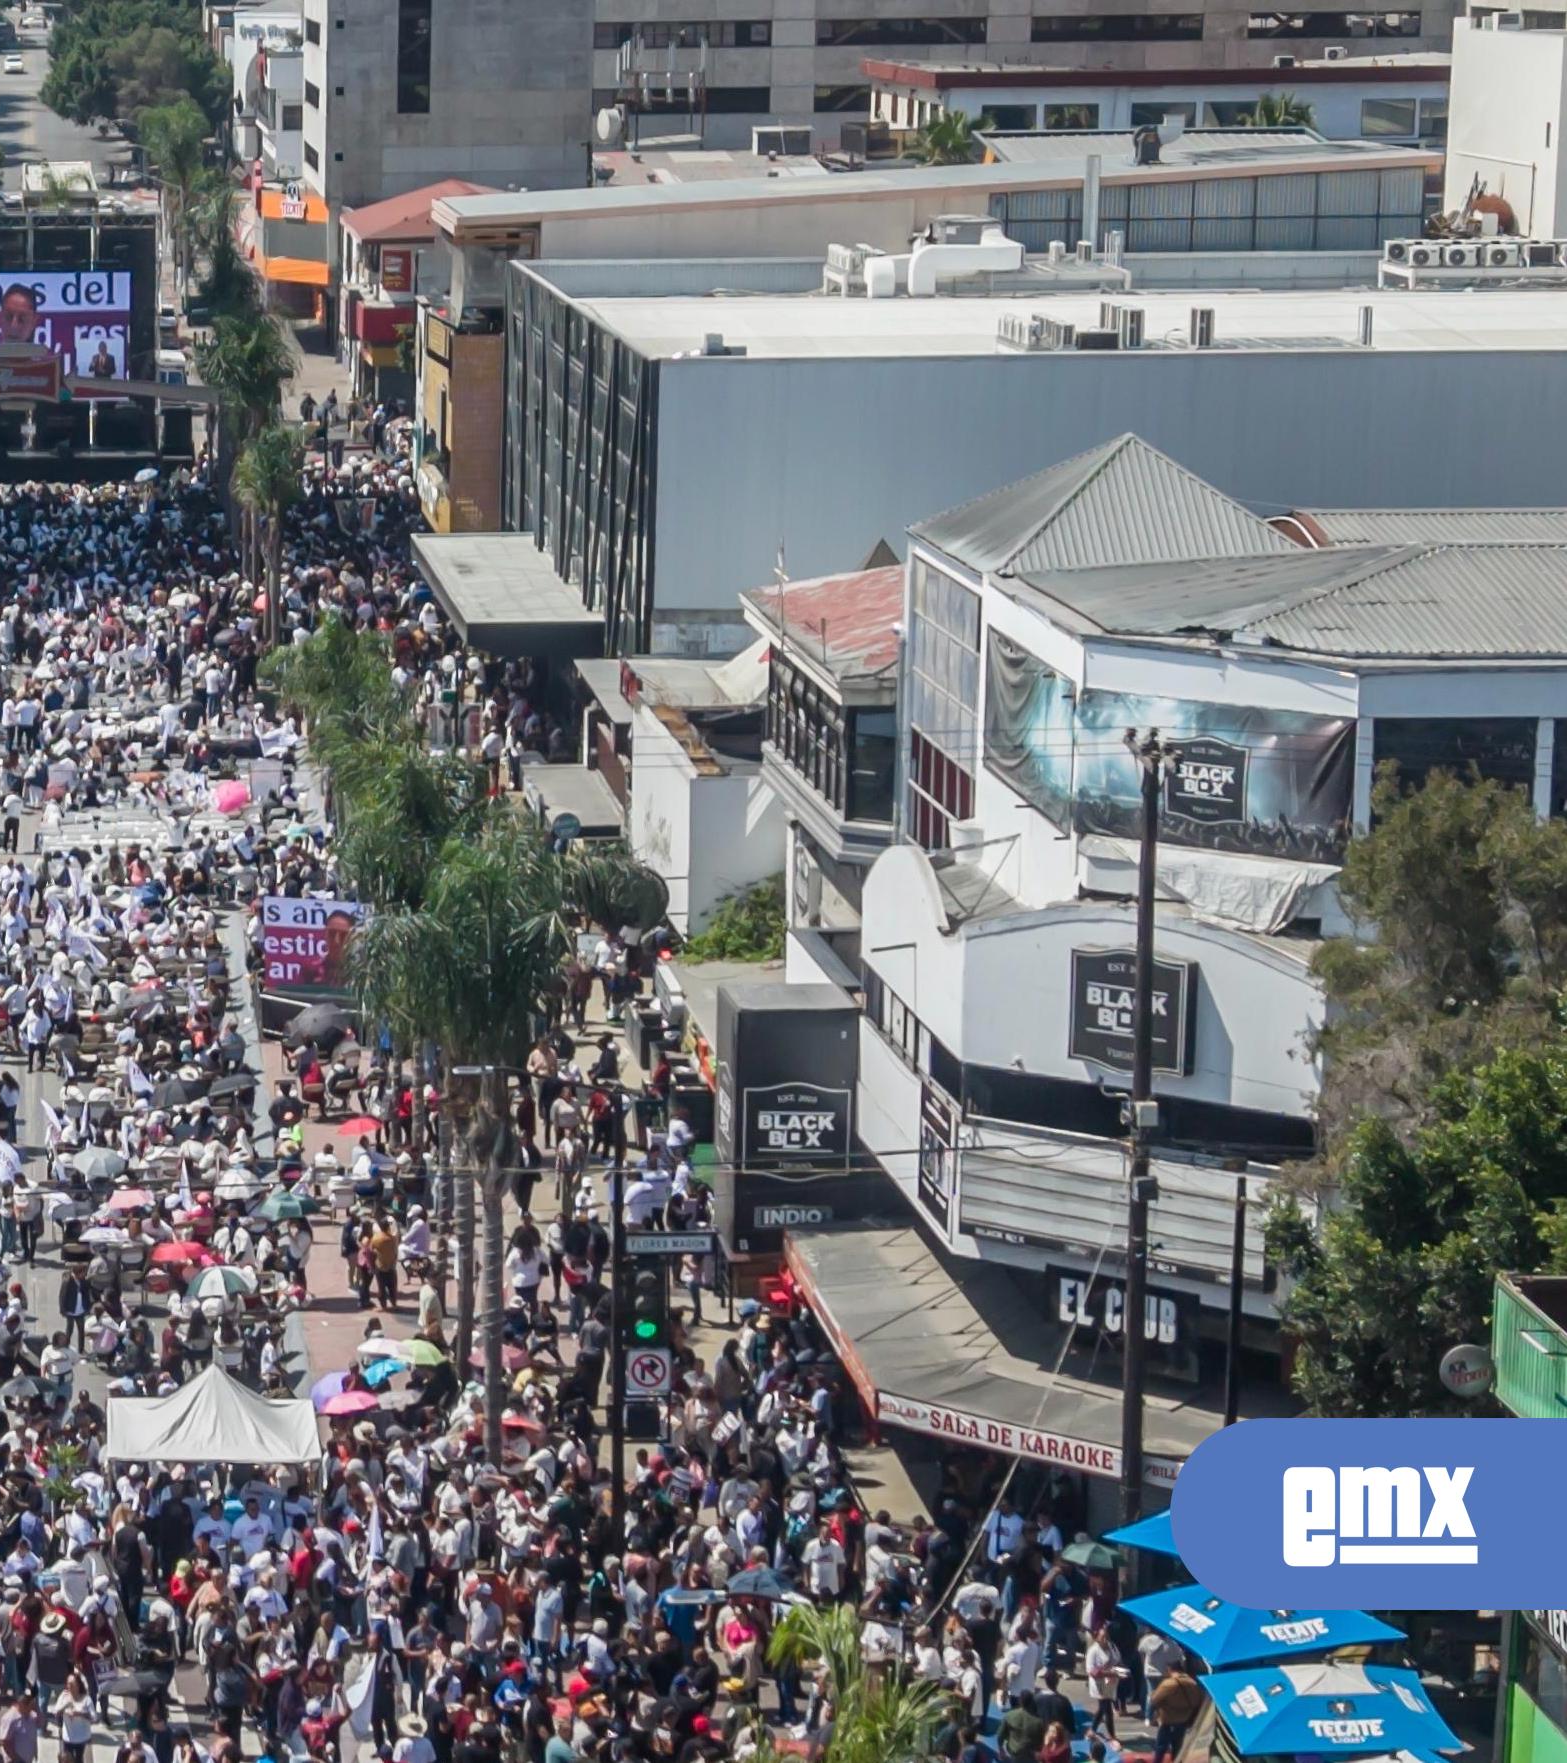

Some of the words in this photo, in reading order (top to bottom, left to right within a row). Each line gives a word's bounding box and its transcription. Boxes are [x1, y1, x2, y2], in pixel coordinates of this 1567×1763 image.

[61, 271, 115, 306] del
[1086, 985, 1168, 1016] BLAK
[758, 1112, 835, 1131] BLACK
[763, 1209, 822, 1225] INDIO
[631, 1239, 668, 1249] FLORES
[1059, 1277, 1095, 1327] EL
[929, 1409, 981, 1440] SALA
[987, 1424, 1013, 1447] DE
[1020, 1432, 1114, 1471] KARAOKE
[1260, 1617, 1330, 1641] TECATE
[1308, 1718, 1385, 1738] TECATE
